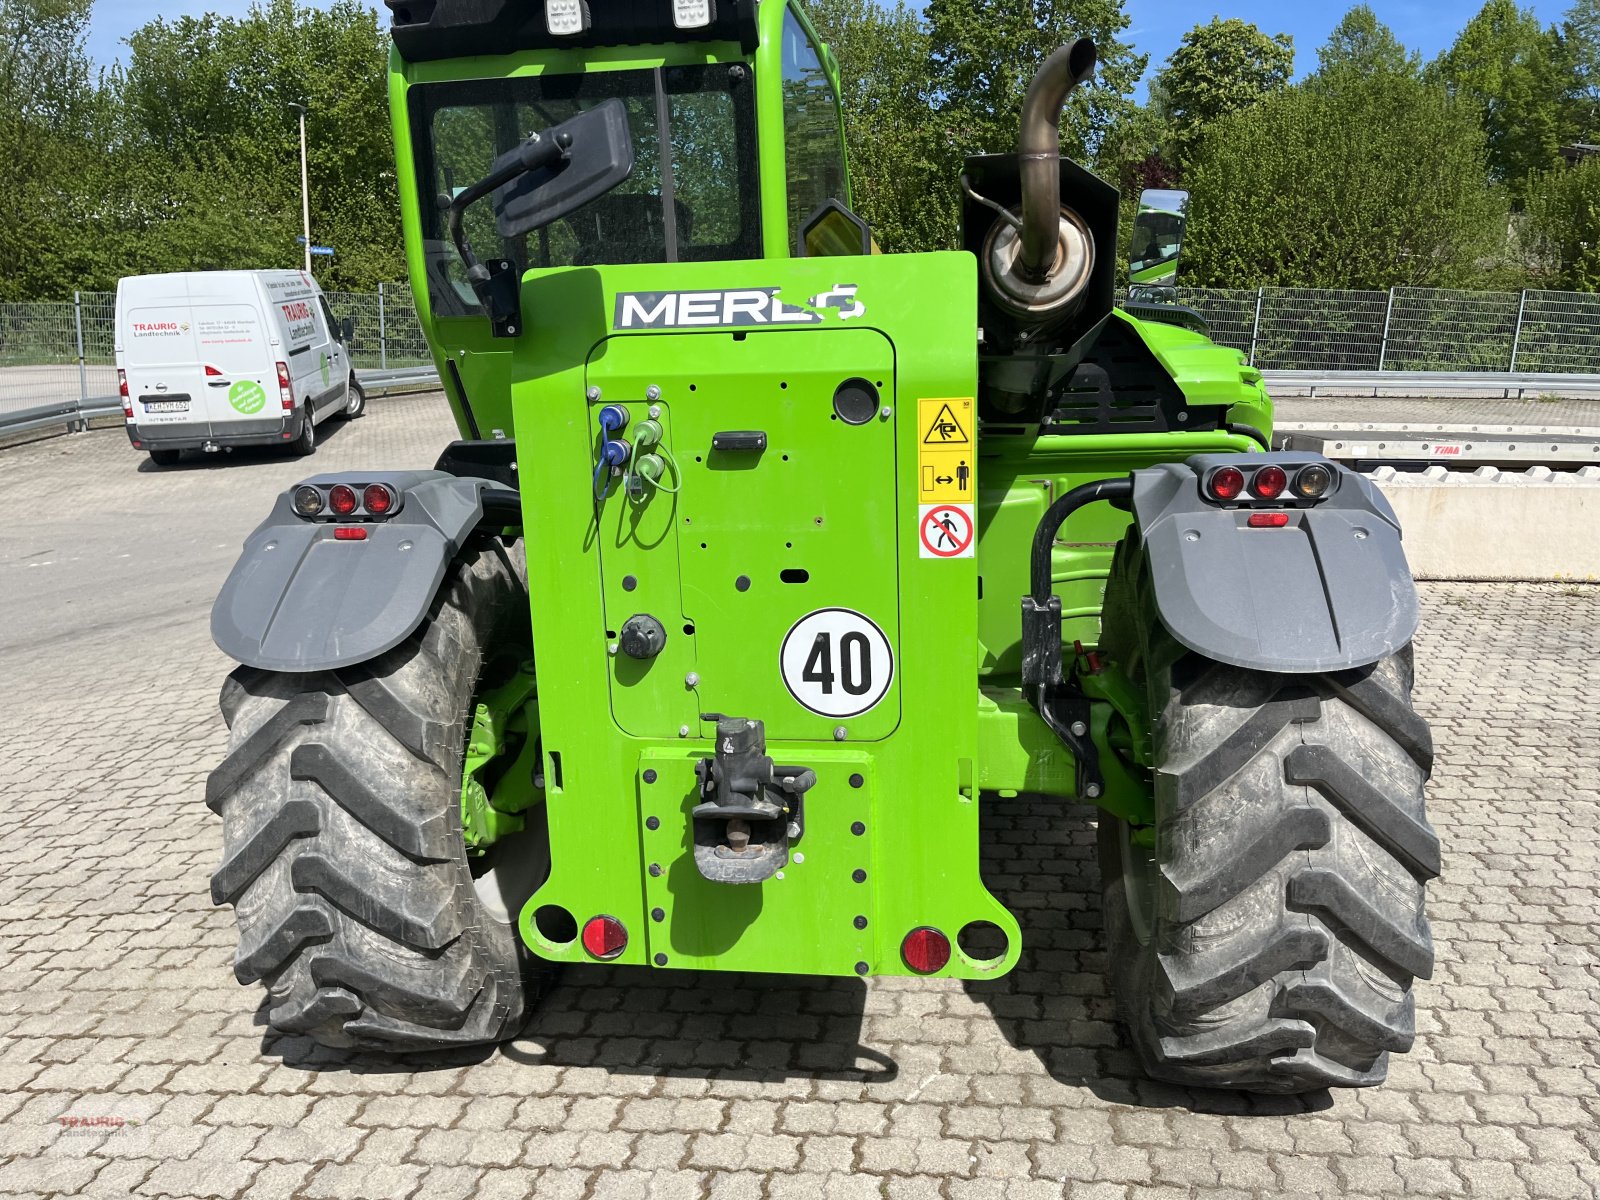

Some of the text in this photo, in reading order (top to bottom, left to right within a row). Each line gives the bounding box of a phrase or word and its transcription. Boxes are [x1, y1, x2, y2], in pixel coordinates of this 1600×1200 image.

[281, 302, 310, 322] TRAURIG
[133, 322, 178, 331] TRAURIG
[133, 330, 181, 338] Landtechnik
[802, 631, 872, 695] 40
